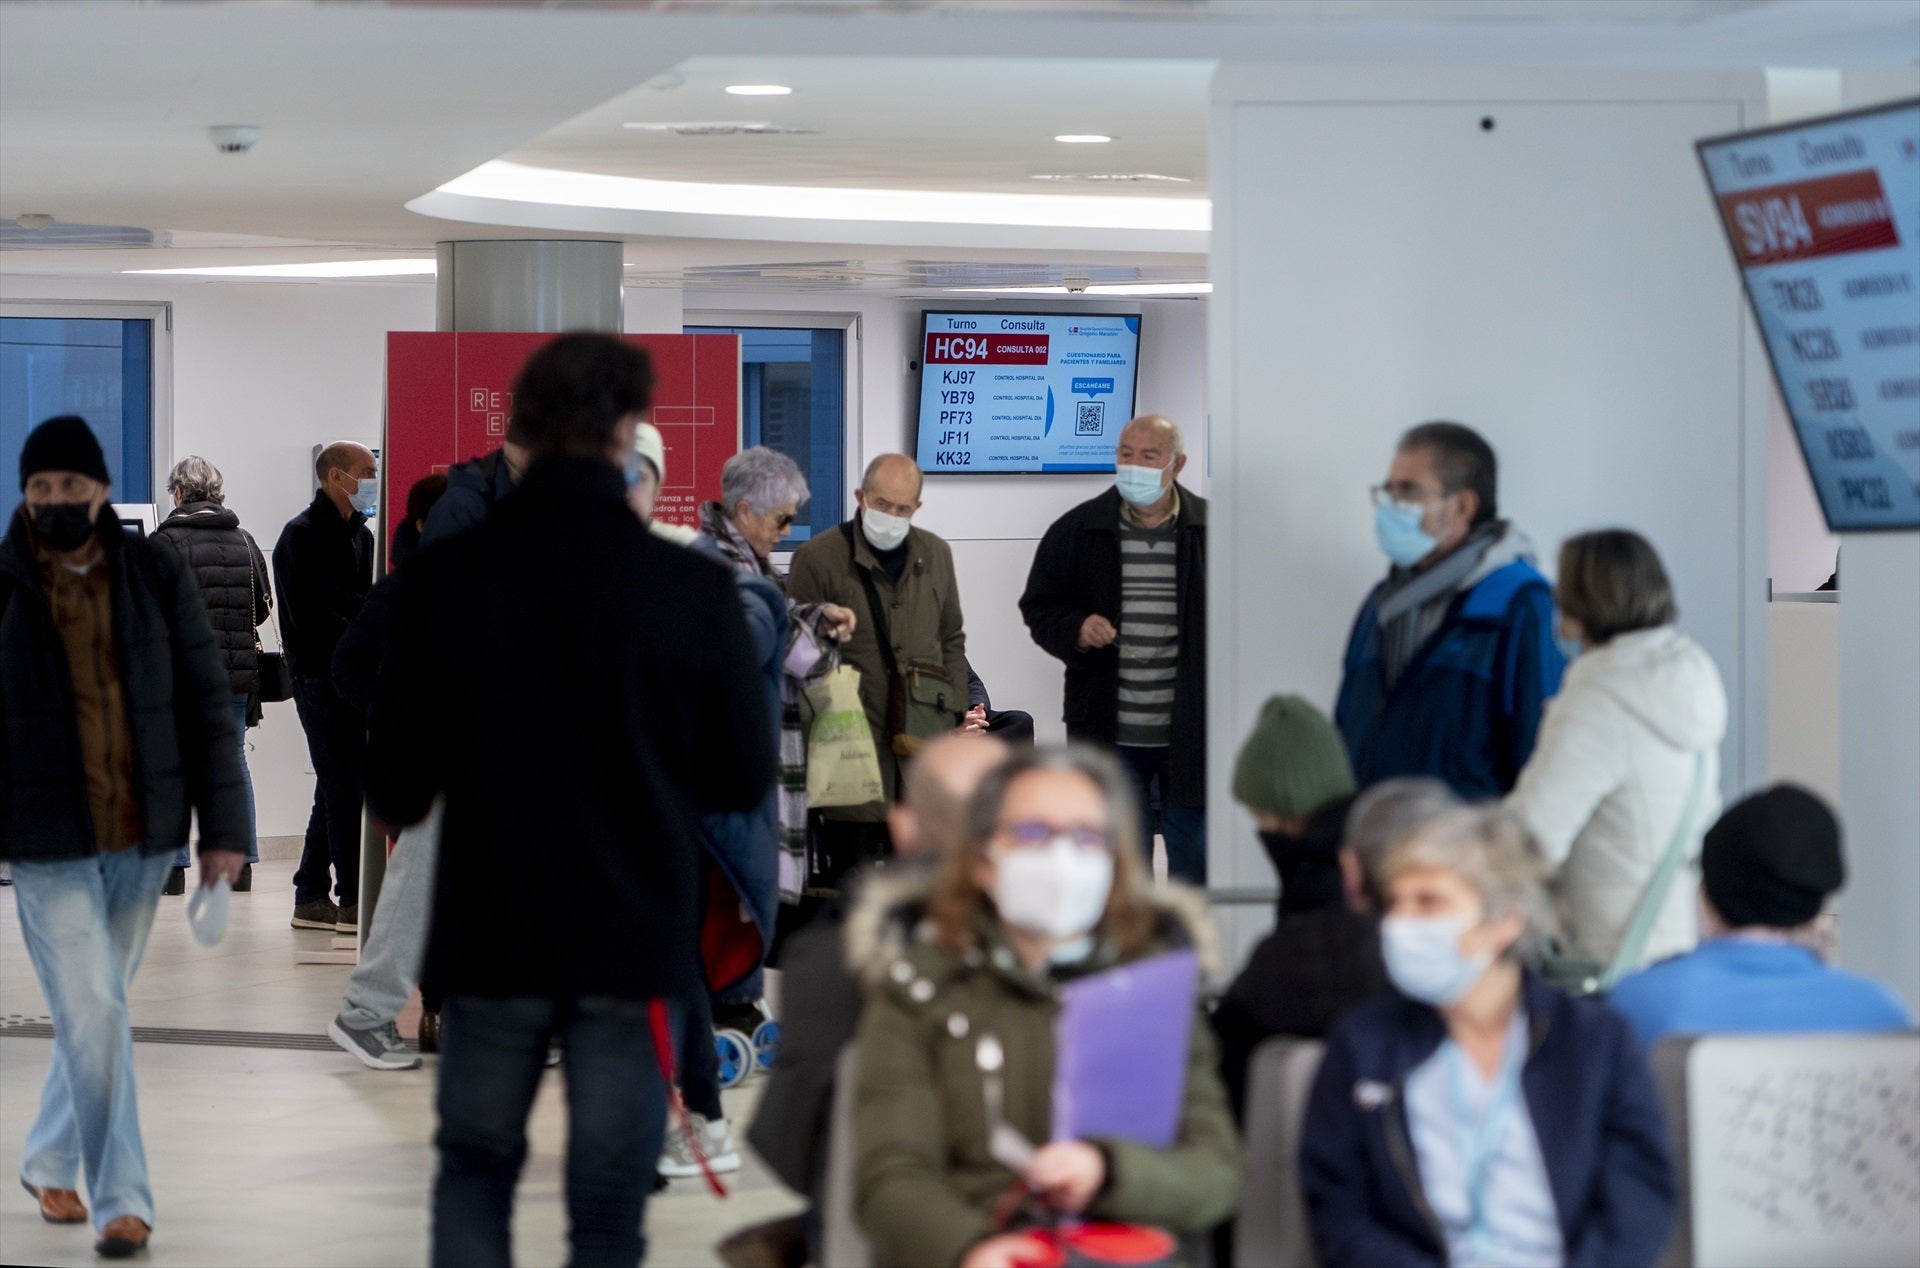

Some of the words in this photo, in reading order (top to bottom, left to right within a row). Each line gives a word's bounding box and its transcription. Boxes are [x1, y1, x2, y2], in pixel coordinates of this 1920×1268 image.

[1734, 193, 1814, 257] SV94
[947, 318, 977, 330] Turno
[1001, 319, 1045, 331] Consulta
[935, 337, 988, 360] HC94
[997, 345, 1034, 354] CONSULTA
[1035, 346, 1047, 354] 002
[943, 370, 976, 385] KJ97
[474, 392, 515, 408] RET
[941, 390, 975, 405] YB79
[940, 411, 973, 425] PF73
[939, 431, 969, 445] JF11
[936, 451, 971, 466] KK32
[668, 514, 678, 522] de
[683, 514, 695, 522] los
